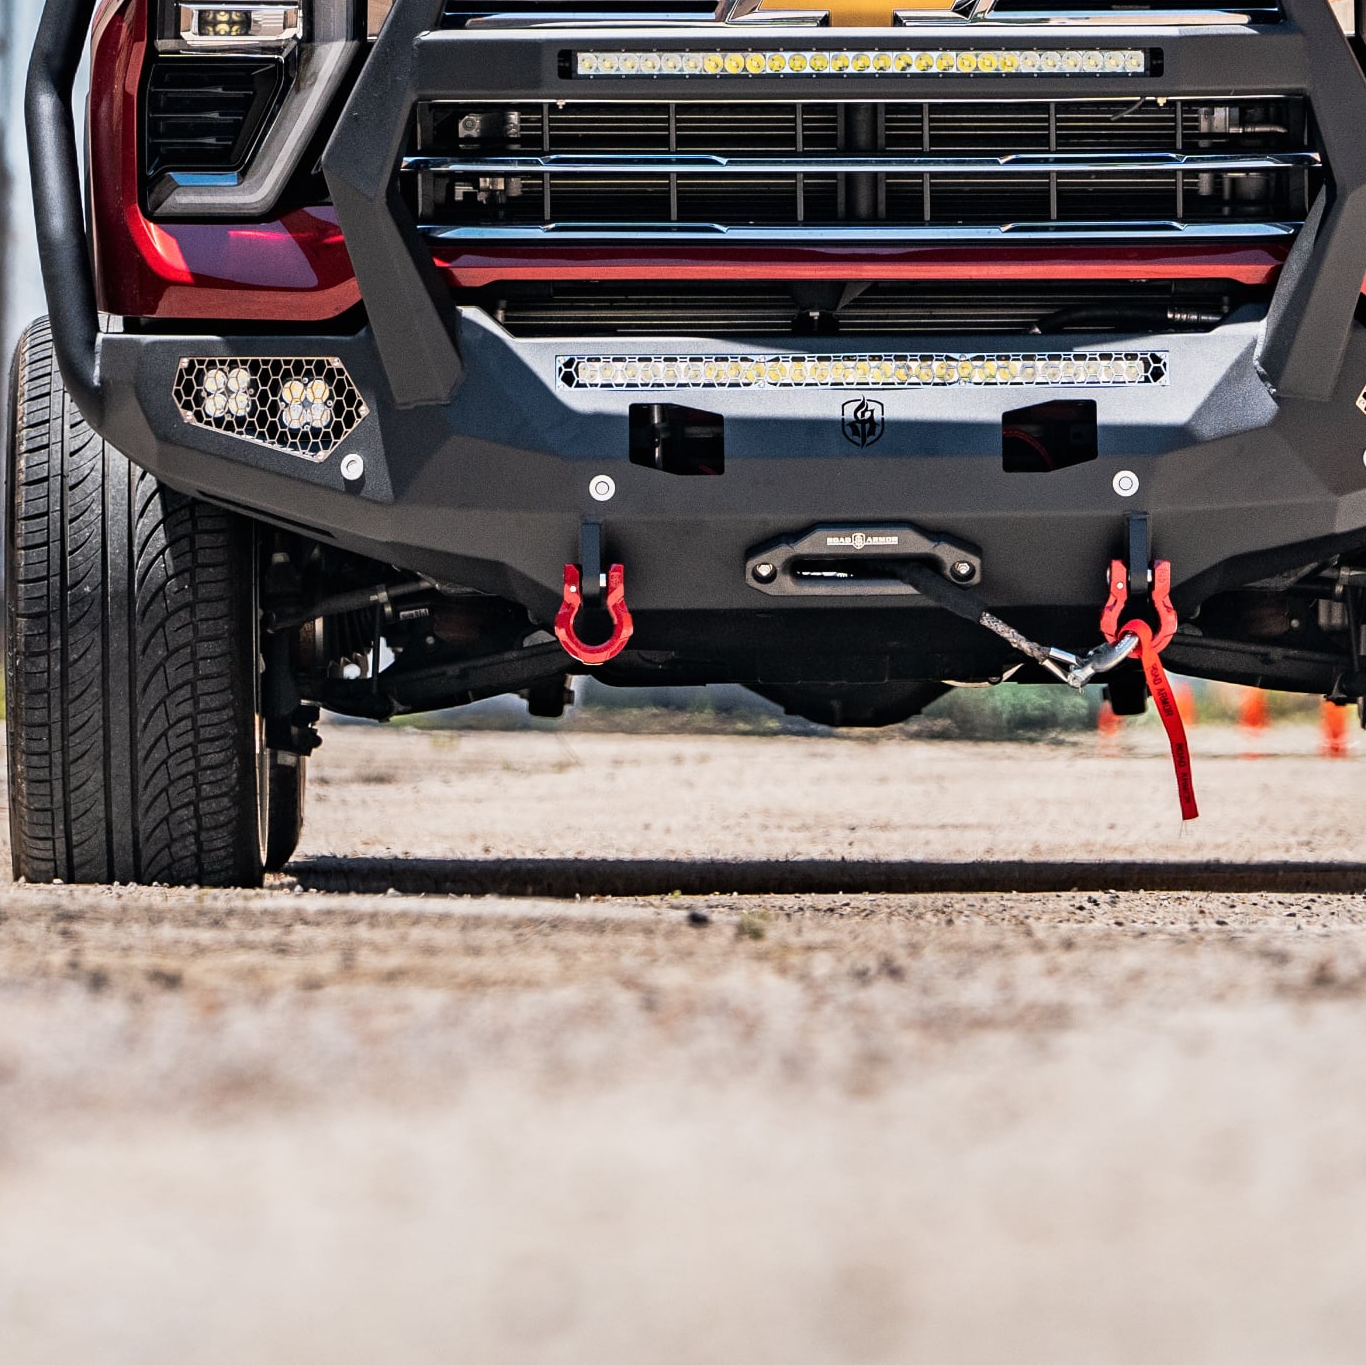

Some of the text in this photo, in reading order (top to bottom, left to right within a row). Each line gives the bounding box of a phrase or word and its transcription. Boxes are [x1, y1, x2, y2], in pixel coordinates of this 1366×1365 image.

[826, 536, 899, 544] ROAD ARMOR
[1150, 662, 1174, 717] ROAD ARMOR
